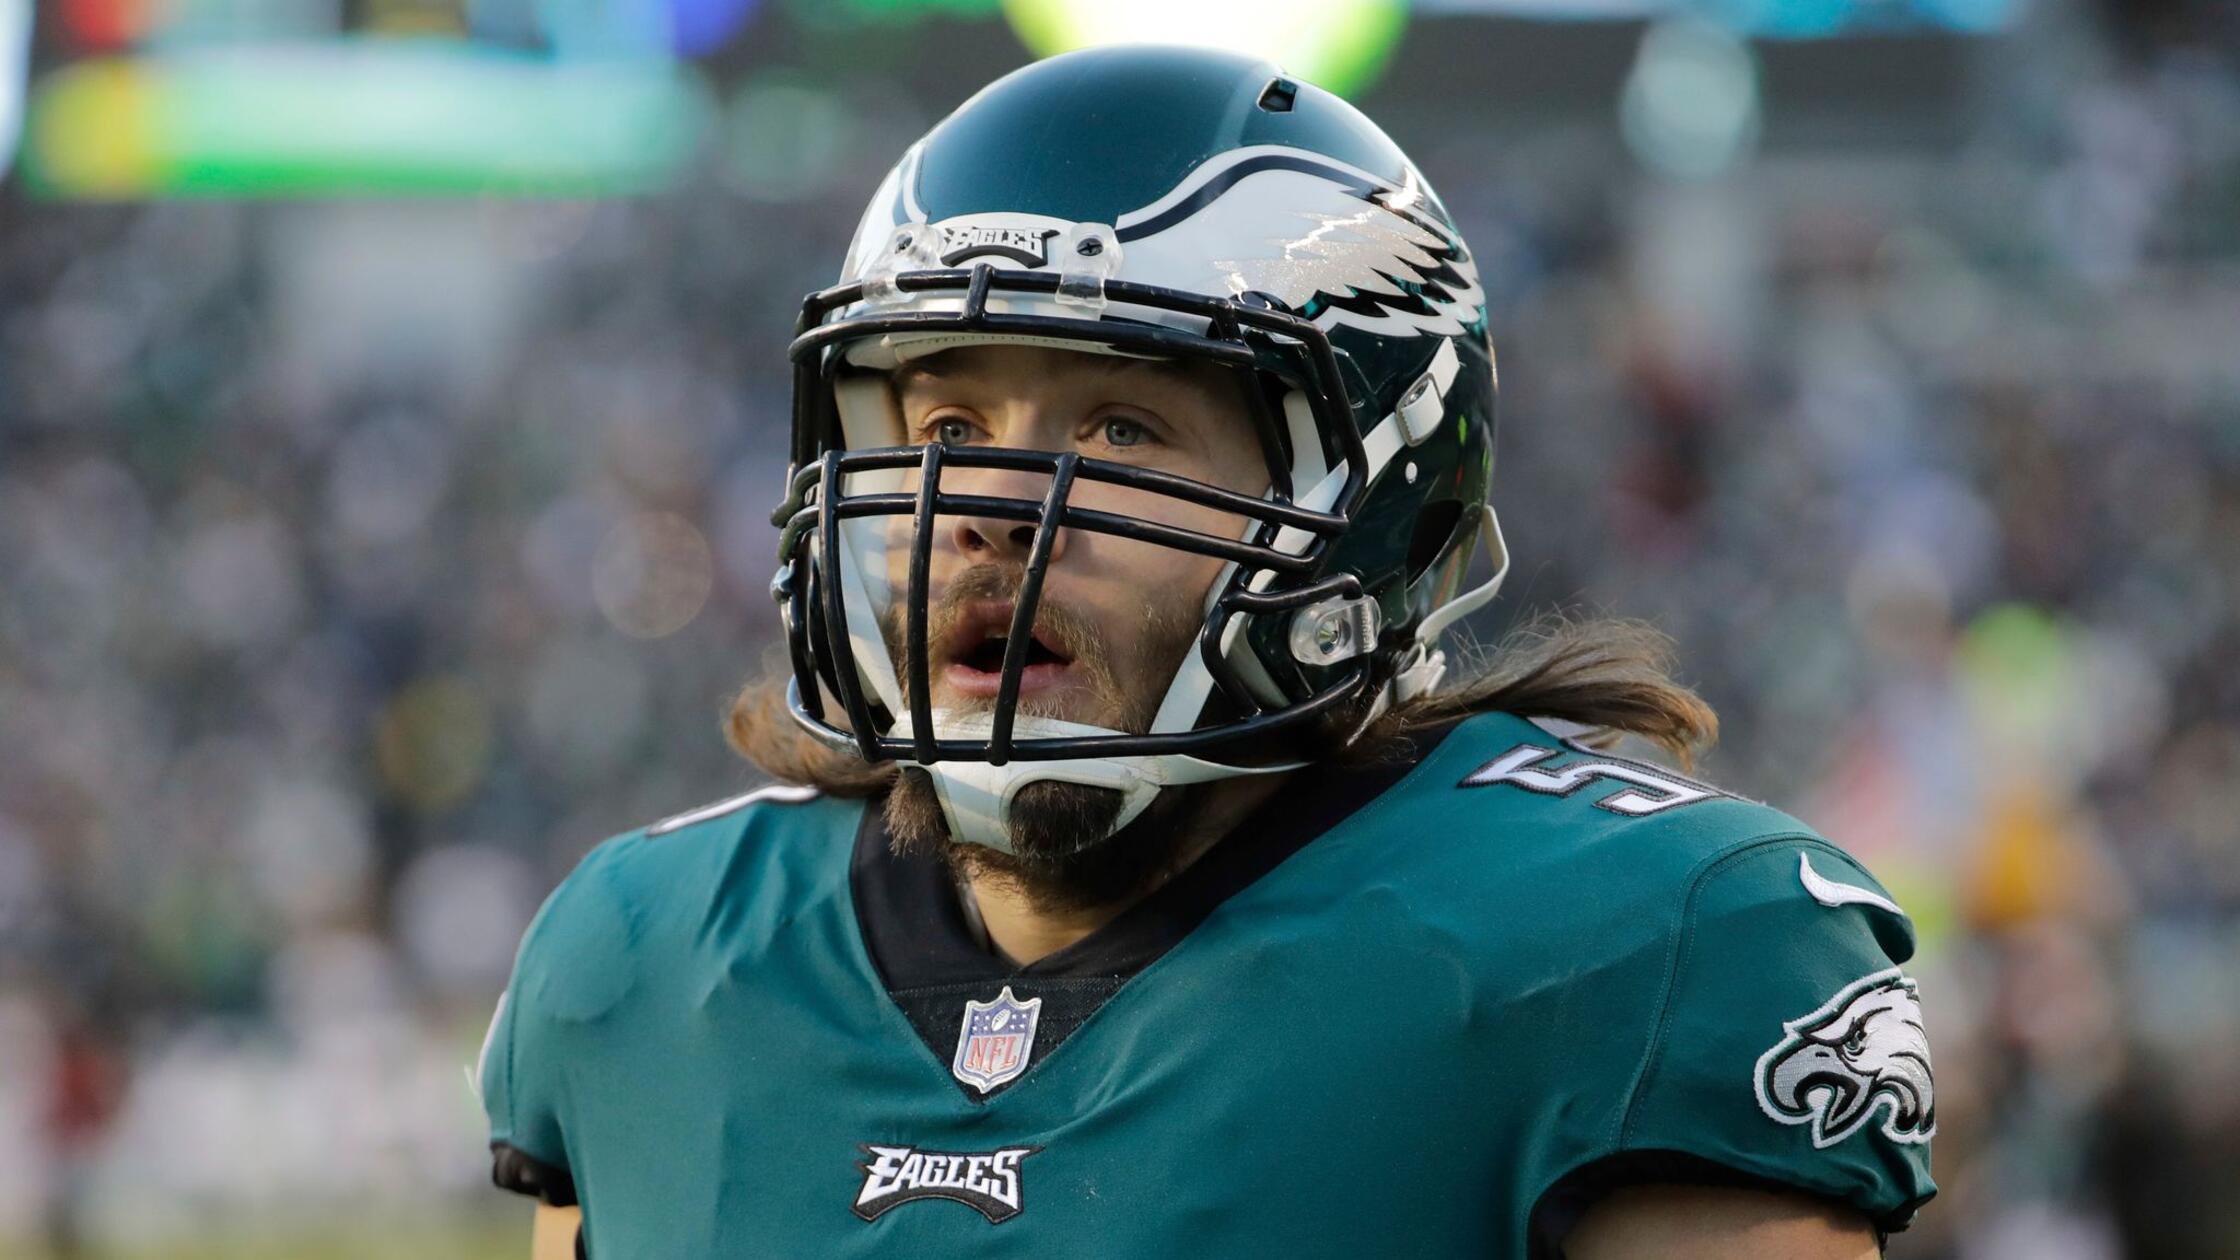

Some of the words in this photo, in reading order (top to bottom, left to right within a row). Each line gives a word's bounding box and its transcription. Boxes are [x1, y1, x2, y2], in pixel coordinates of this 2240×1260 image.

[941, 226, 1054, 261] EAGLES
[964, 1035, 1019, 1074] NFL
[855, 1146, 1031, 1210] EAGLES
